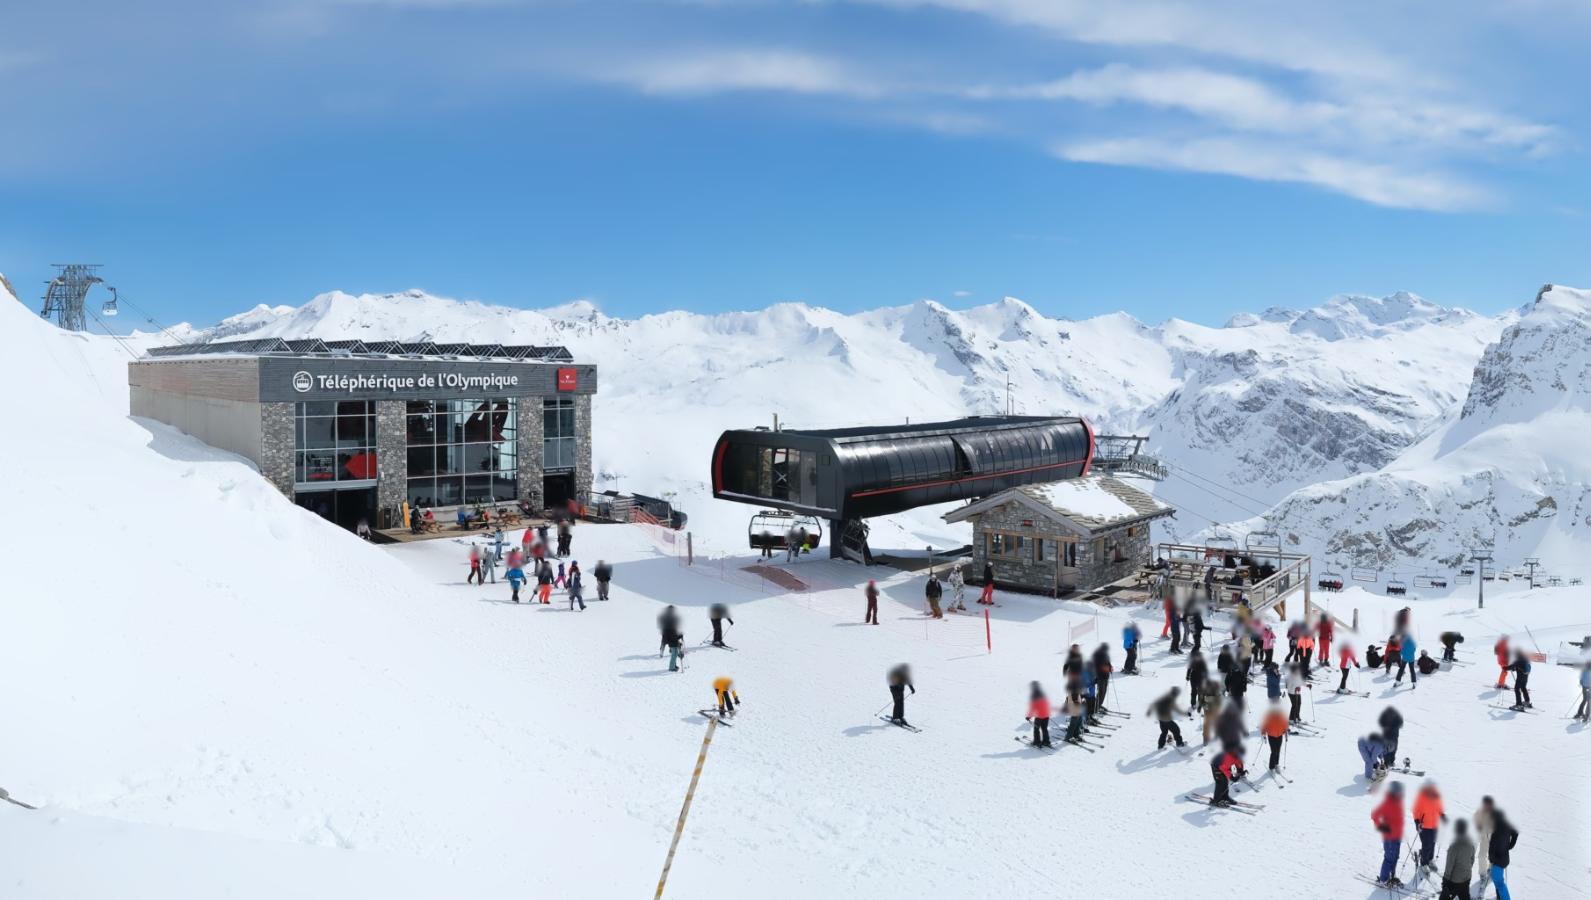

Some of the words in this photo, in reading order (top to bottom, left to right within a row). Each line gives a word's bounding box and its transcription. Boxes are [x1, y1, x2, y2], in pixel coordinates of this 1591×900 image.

[317, 375, 414, 392] Téléphérique
[418, 374, 434, 388] de
[438, 373, 519, 391] l'Olympique
